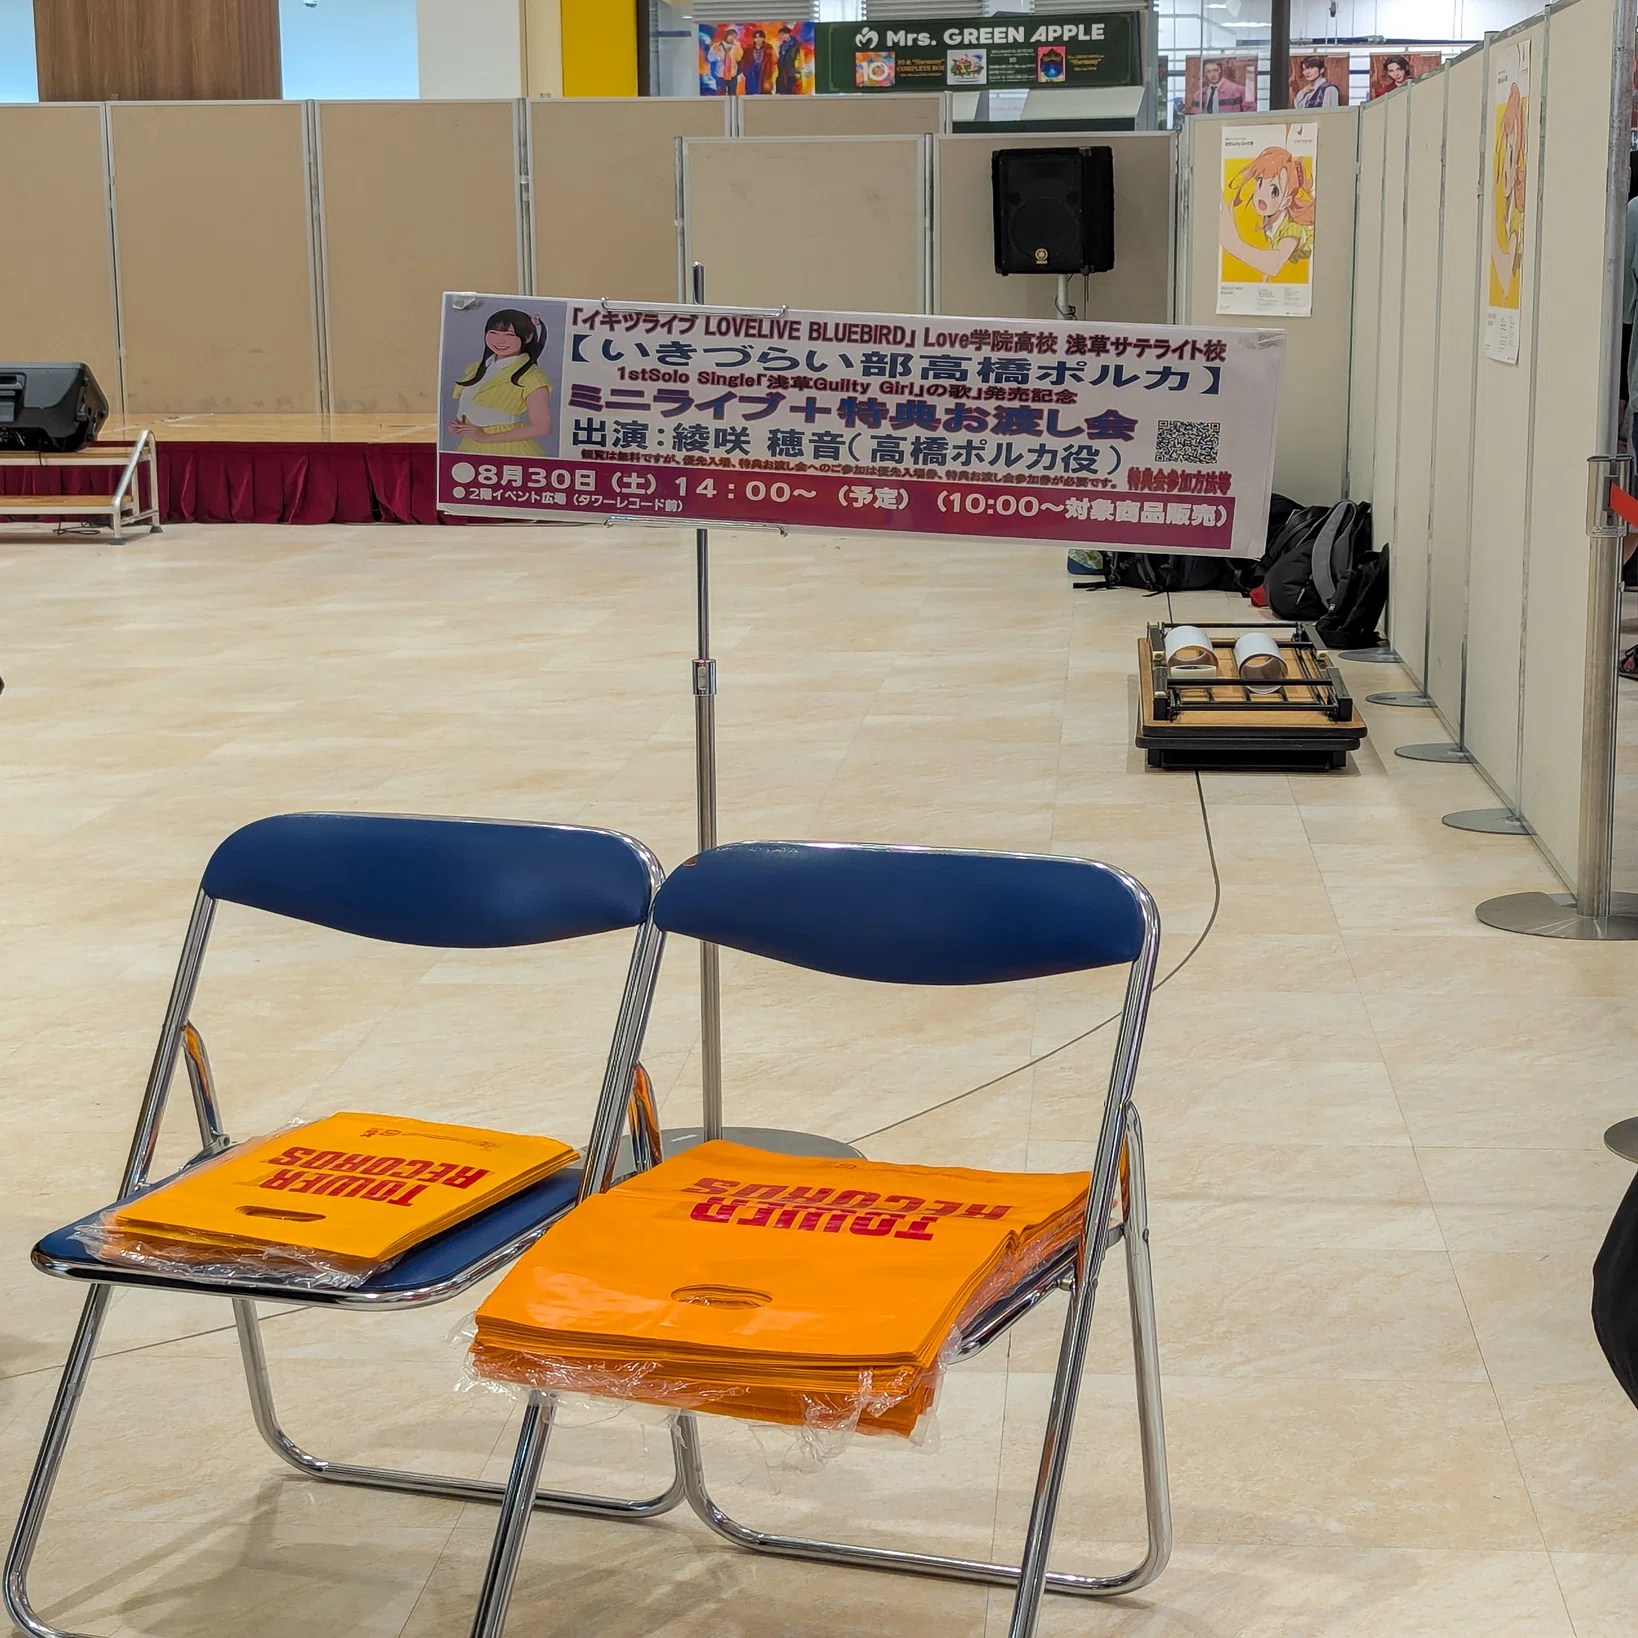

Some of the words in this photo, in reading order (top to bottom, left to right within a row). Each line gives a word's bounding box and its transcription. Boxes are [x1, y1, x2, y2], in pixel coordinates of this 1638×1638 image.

[886, 30, 937, 47] Mrs.
[943, 26, 1025, 45] GREEN
[1030, 23, 1106, 43] APPLE
[704, 314, 802, 341] LOVELIVE
[808, 321, 917, 349] BLUEBIRD」
[923, 327, 1058, 356] Love学院高校
[1064, 332, 1228, 363] 浅草サテライト校
[571, 333, 1223, 395] 【いきづらい部高橋ポルカ】
[616, 366, 690, 384] 1stSolo
[568, 383, 1139, 442] ミニライブ＋特典お渡し会
[767, 427, 1122, 476] 穂音（高橋ポルカ役）
[259, 1168, 431, 1208] TOWER
[267, 1146, 491, 1190] RECORDS
[681, 1177, 1013, 1220] RECORDS
[689, 1196, 935, 1241] TOWER
